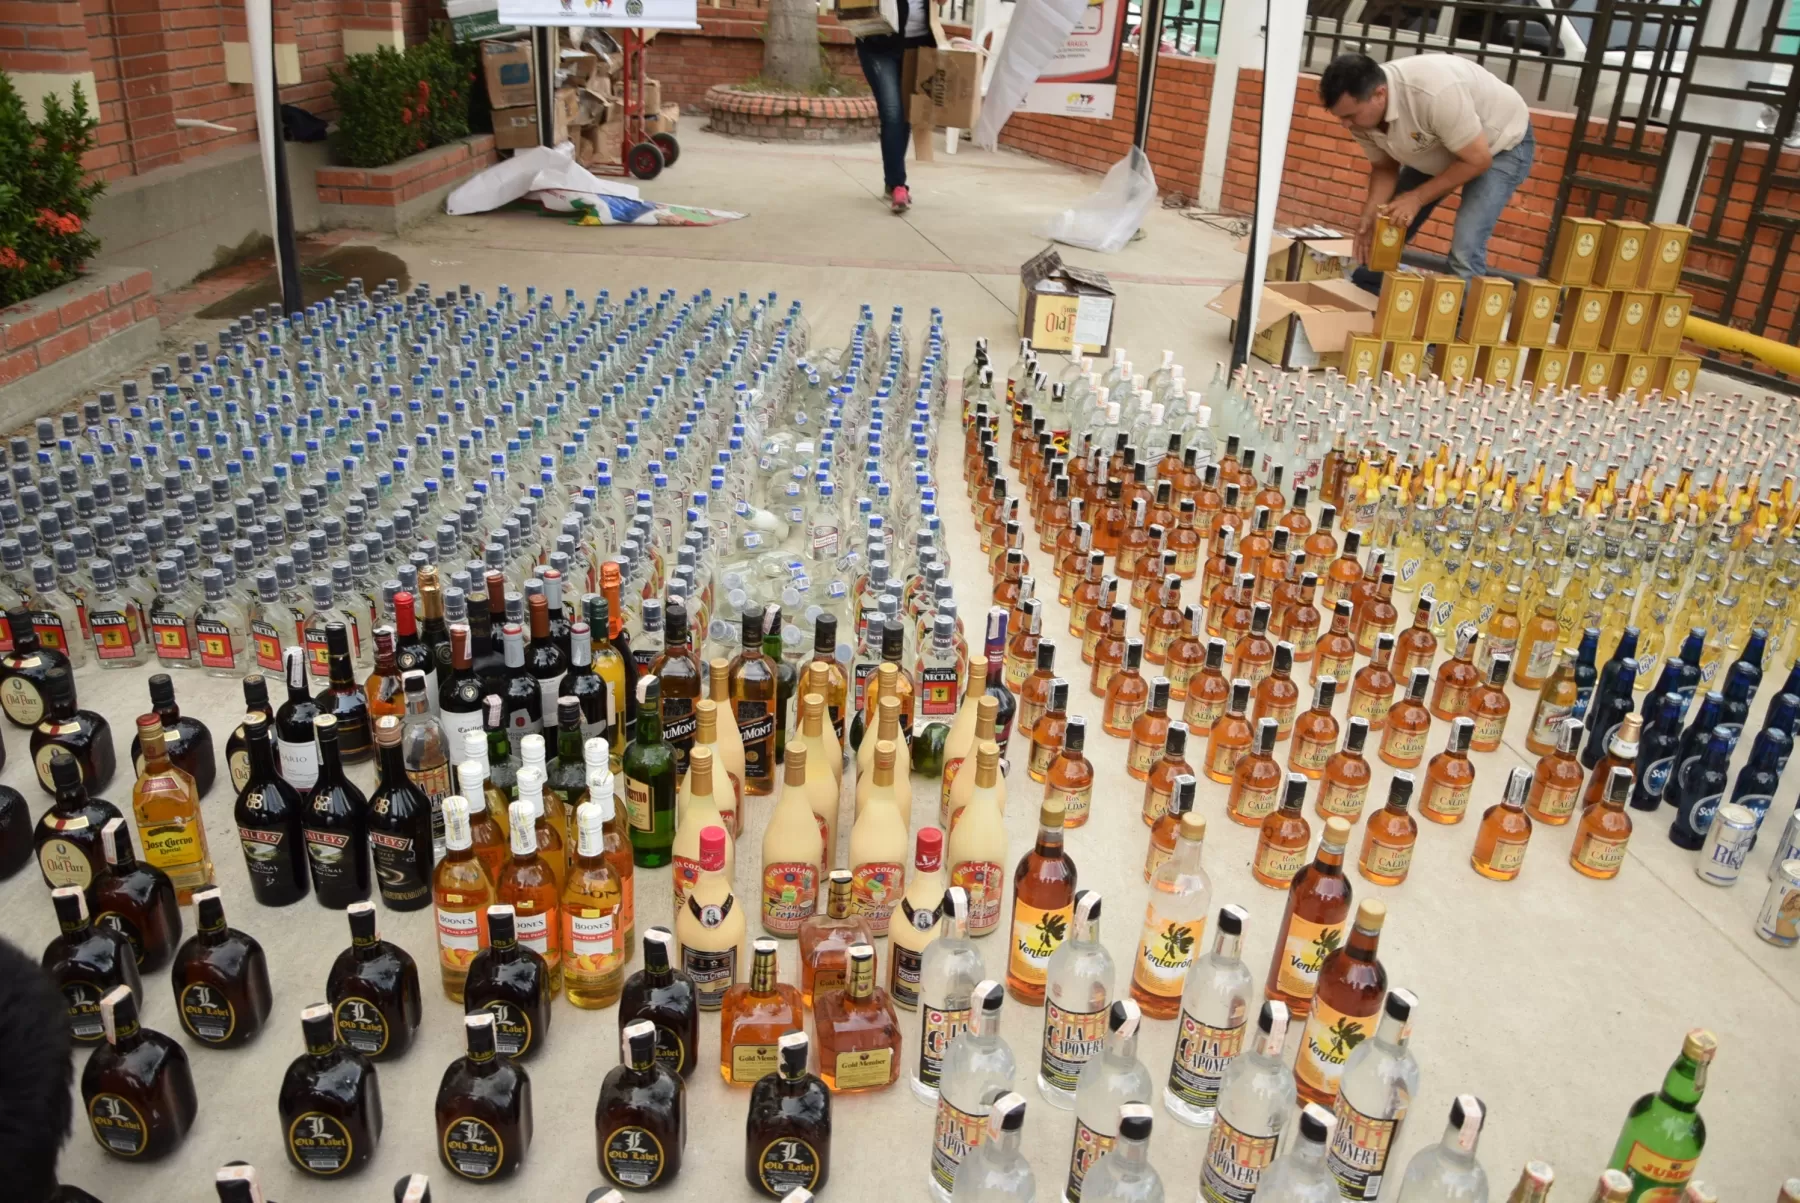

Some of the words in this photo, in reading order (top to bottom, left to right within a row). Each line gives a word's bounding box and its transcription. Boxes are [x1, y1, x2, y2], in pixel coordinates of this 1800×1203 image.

[1045, 312, 1066, 333] Old
[91, 616, 126, 626] NECTAR
[152, 616, 184, 627] NECTAR
[197, 625, 229, 635] NECTAR
[252, 624, 278, 638] NECTAR
[306, 633, 328, 643] NECT
[924, 672, 957, 682] NECTAR
[6, 694, 21, 706] Old
[20, 694, 37, 706] Parr
[145, 840, 162, 851] Jose
[164, 837, 193, 849] Cuervo
[1282, 855, 1297, 863] Ron
[47, 860, 64, 872] Old
[64, 861, 84, 873] Parr
[858, 867, 873, 879] PIÑA
[1018, 938, 1054, 957] Ventar
[1144, 945, 1193, 969] Ventarrón
[1291, 954, 1321, 974] Venta
[709, 970, 730, 982] Crema
[193, 985, 218, 1009] L
[185, 1005, 203, 1014] Old
[205, 1007, 230, 1017] Label
[347, 1001, 373, 1024] L
[490, 1004, 516, 1026] L
[339, 1019, 359, 1029] Old
[361, 1022, 383, 1033] Label
[502, 1024, 526, 1034] Label
[1066, 1025, 1084, 1041] LA
[1201, 1039, 1220, 1057] LA
[756, 1054, 778, 1062] Memb
[859, 1059, 886, 1068] Member
[101, 1096, 130, 1121] L
[94, 1115, 113, 1126] Old
[116, 1119, 141, 1131] Label
[304, 1115, 335, 1139] L
[459, 1120, 487, 1145] L
[950, 1120, 965, 1141] LA
[294, 1137, 315, 1146] Old
[318, 1137, 347, 1147] Label
[447, 1140, 467, 1151] Old
[472, 1143, 498, 1153] Label
[621, 1129, 649, 1153] L
[777, 1141, 805, 1164] L
[1219, 1137, 1237, 1160] LA
[608, 1150, 629, 1160] Old
[632, 1151, 659, 1162] Label
[764, 1161, 783, 1171] Old
[788, 1162, 814, 1173] Label
